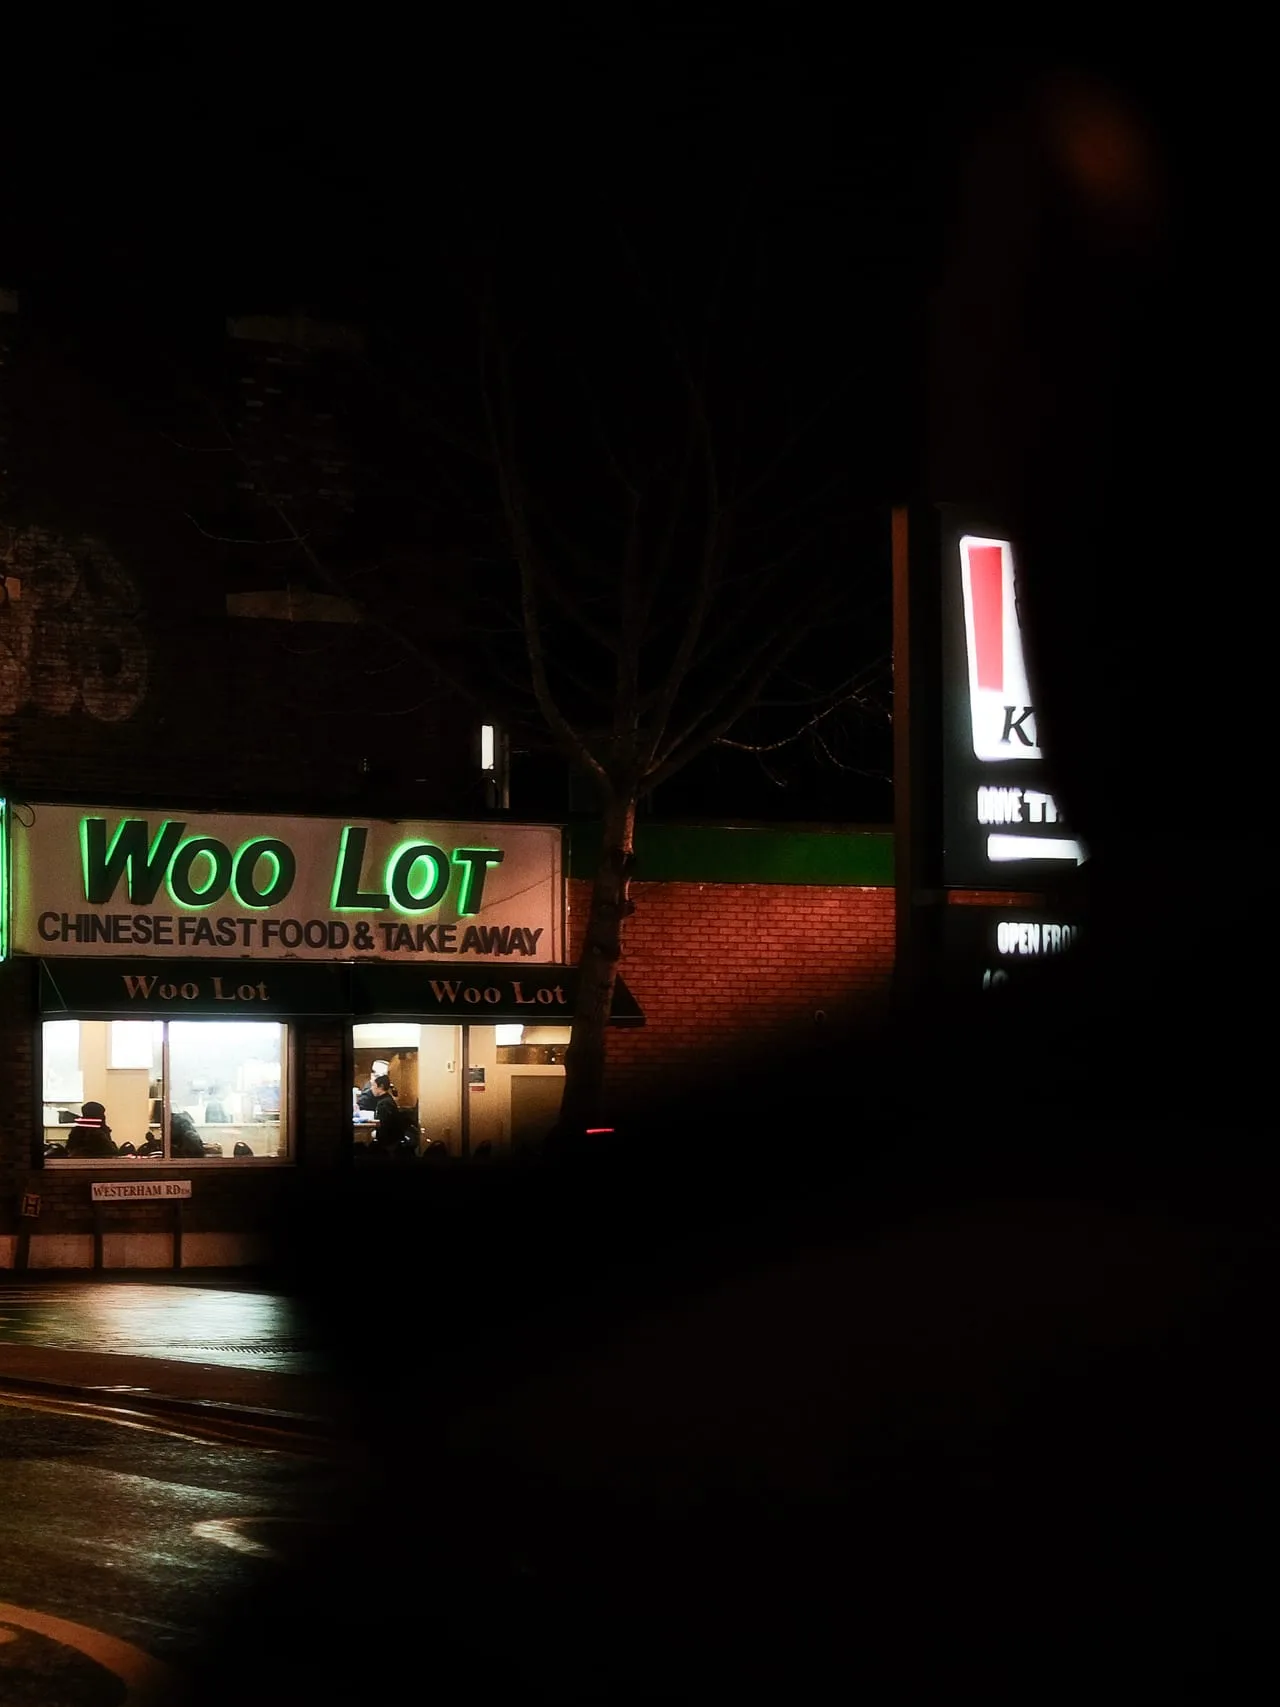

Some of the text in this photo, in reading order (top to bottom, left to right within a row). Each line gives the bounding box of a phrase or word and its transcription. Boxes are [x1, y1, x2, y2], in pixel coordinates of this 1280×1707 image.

[329, 825, 505, 917] LOT
[37, 911, 173, 945] CHINESE
[177, 916, 257, 947] FAST
[262, 919, 350, 950] FOOD
[353, 921, 375, 950] &
[997, 921, 1040, 955] OPEN
[121, 975, 270, 1002] Woo Lot
[427, 979, 568, 1005] Woo Lot
[93, 1184, 162, 1198] WESTERHAM
[165, 1184, 181, 1196] RD
